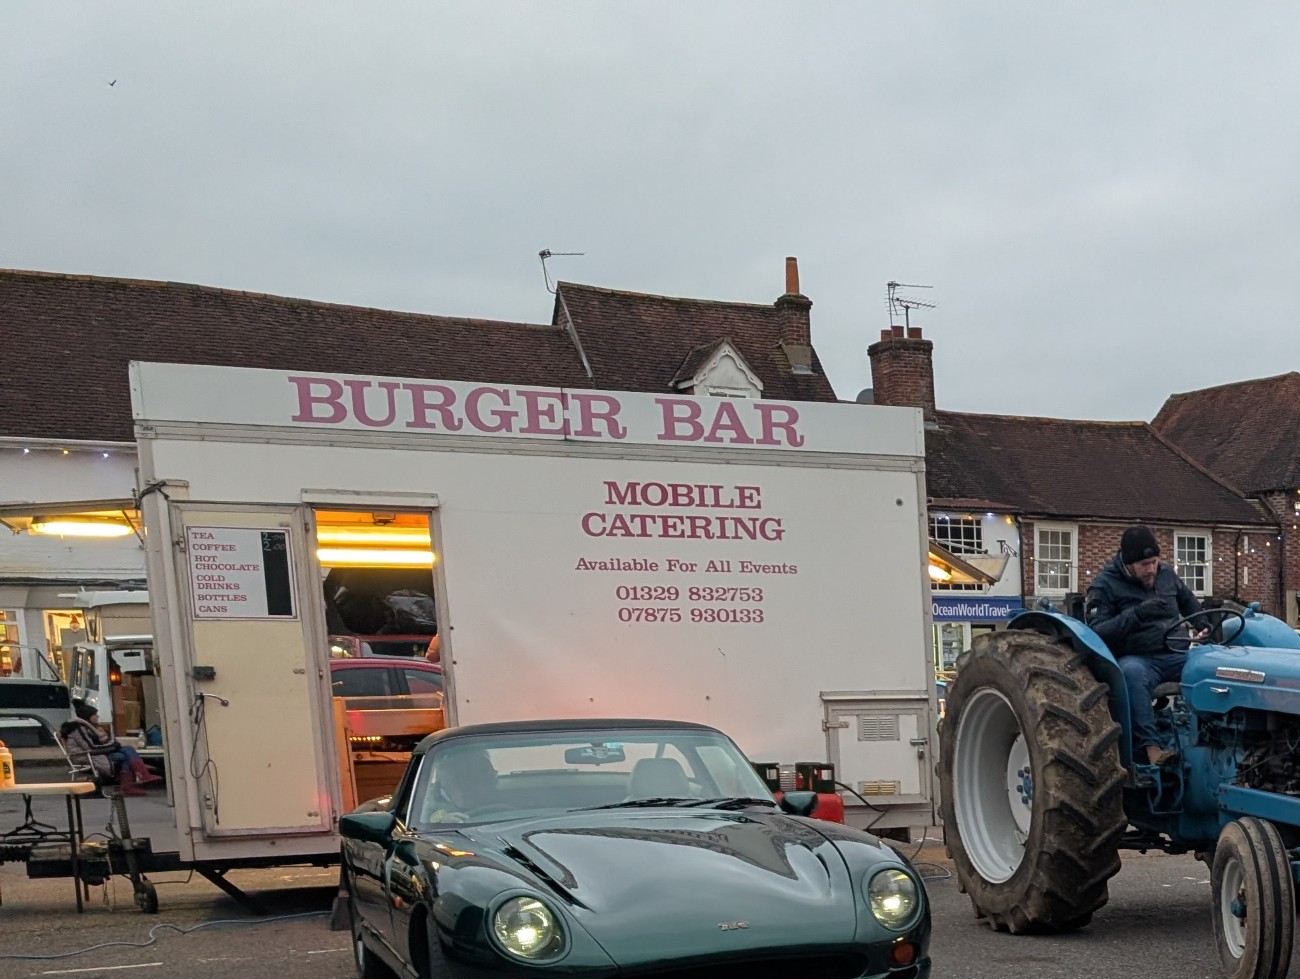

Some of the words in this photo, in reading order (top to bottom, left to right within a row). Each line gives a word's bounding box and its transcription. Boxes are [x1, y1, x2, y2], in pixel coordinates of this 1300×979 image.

[288, 375, 629, 440] BURGER
[654, 397, 805, 448] BAR
[603, 480, 762, 510] MOBILE
[581, 512, 786, 541] CATERING
[192, 532, 215, 540] TEA
[192, 543, 237, 552] COFFEE
[195, 563, 260, 571] CHOCOLATE
[575, 557, 659, 572] Available
[666, 559, 697, 573] For
[705, 560, 732, 573] All
[739, 560, 798, 575] Events
[196, 574, 225, 582] COLD
[197, 594, 247, 602] BOTTLES
[616, 585, 680, 601] 01329
[688, 586, 764, 602] 832753
[199, 605, 228, 613] CANS
[618, 607, 682, 623] 07875
[690, 608, 765, 623] 930133
